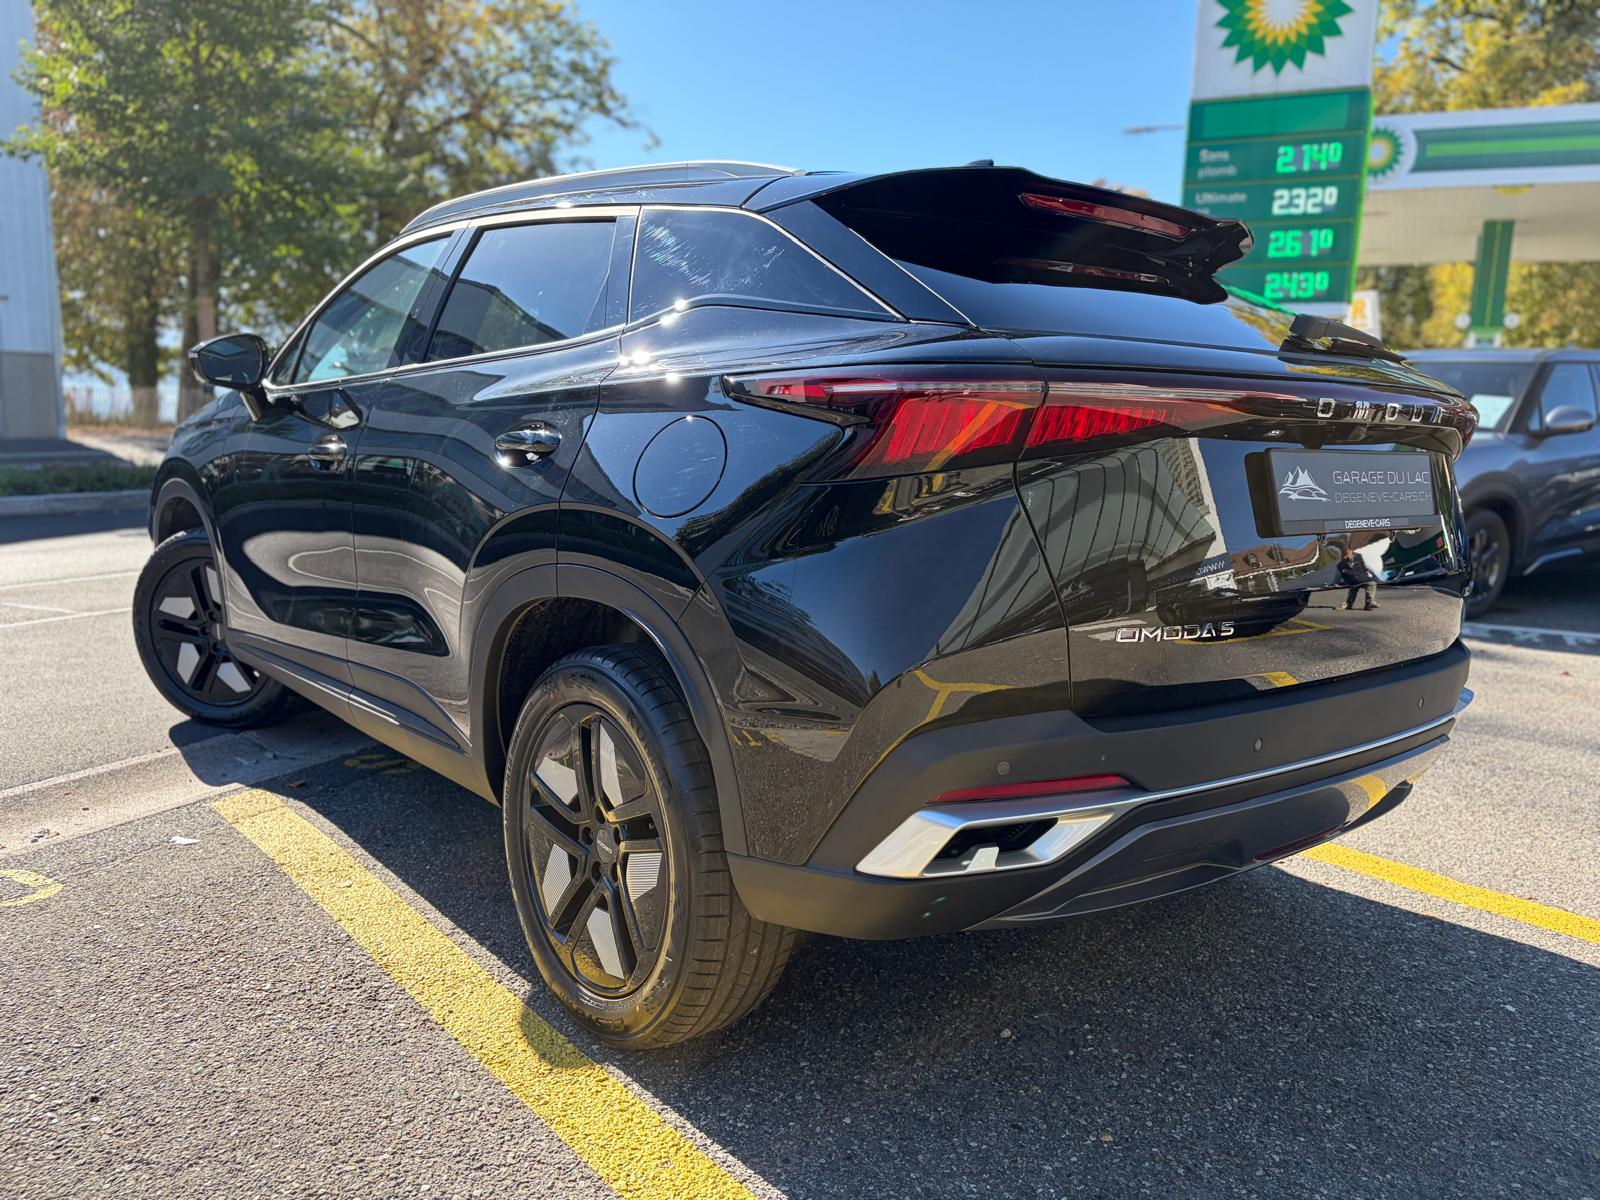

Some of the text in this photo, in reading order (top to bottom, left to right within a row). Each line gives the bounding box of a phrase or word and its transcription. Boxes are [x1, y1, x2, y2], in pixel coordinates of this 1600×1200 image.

[1195, 192, 1247, 205] Ultimate
[1332, 471, 1430, 485] GARAGE DU LAC
[1116, 621, 1235, 642] OMODA 5
